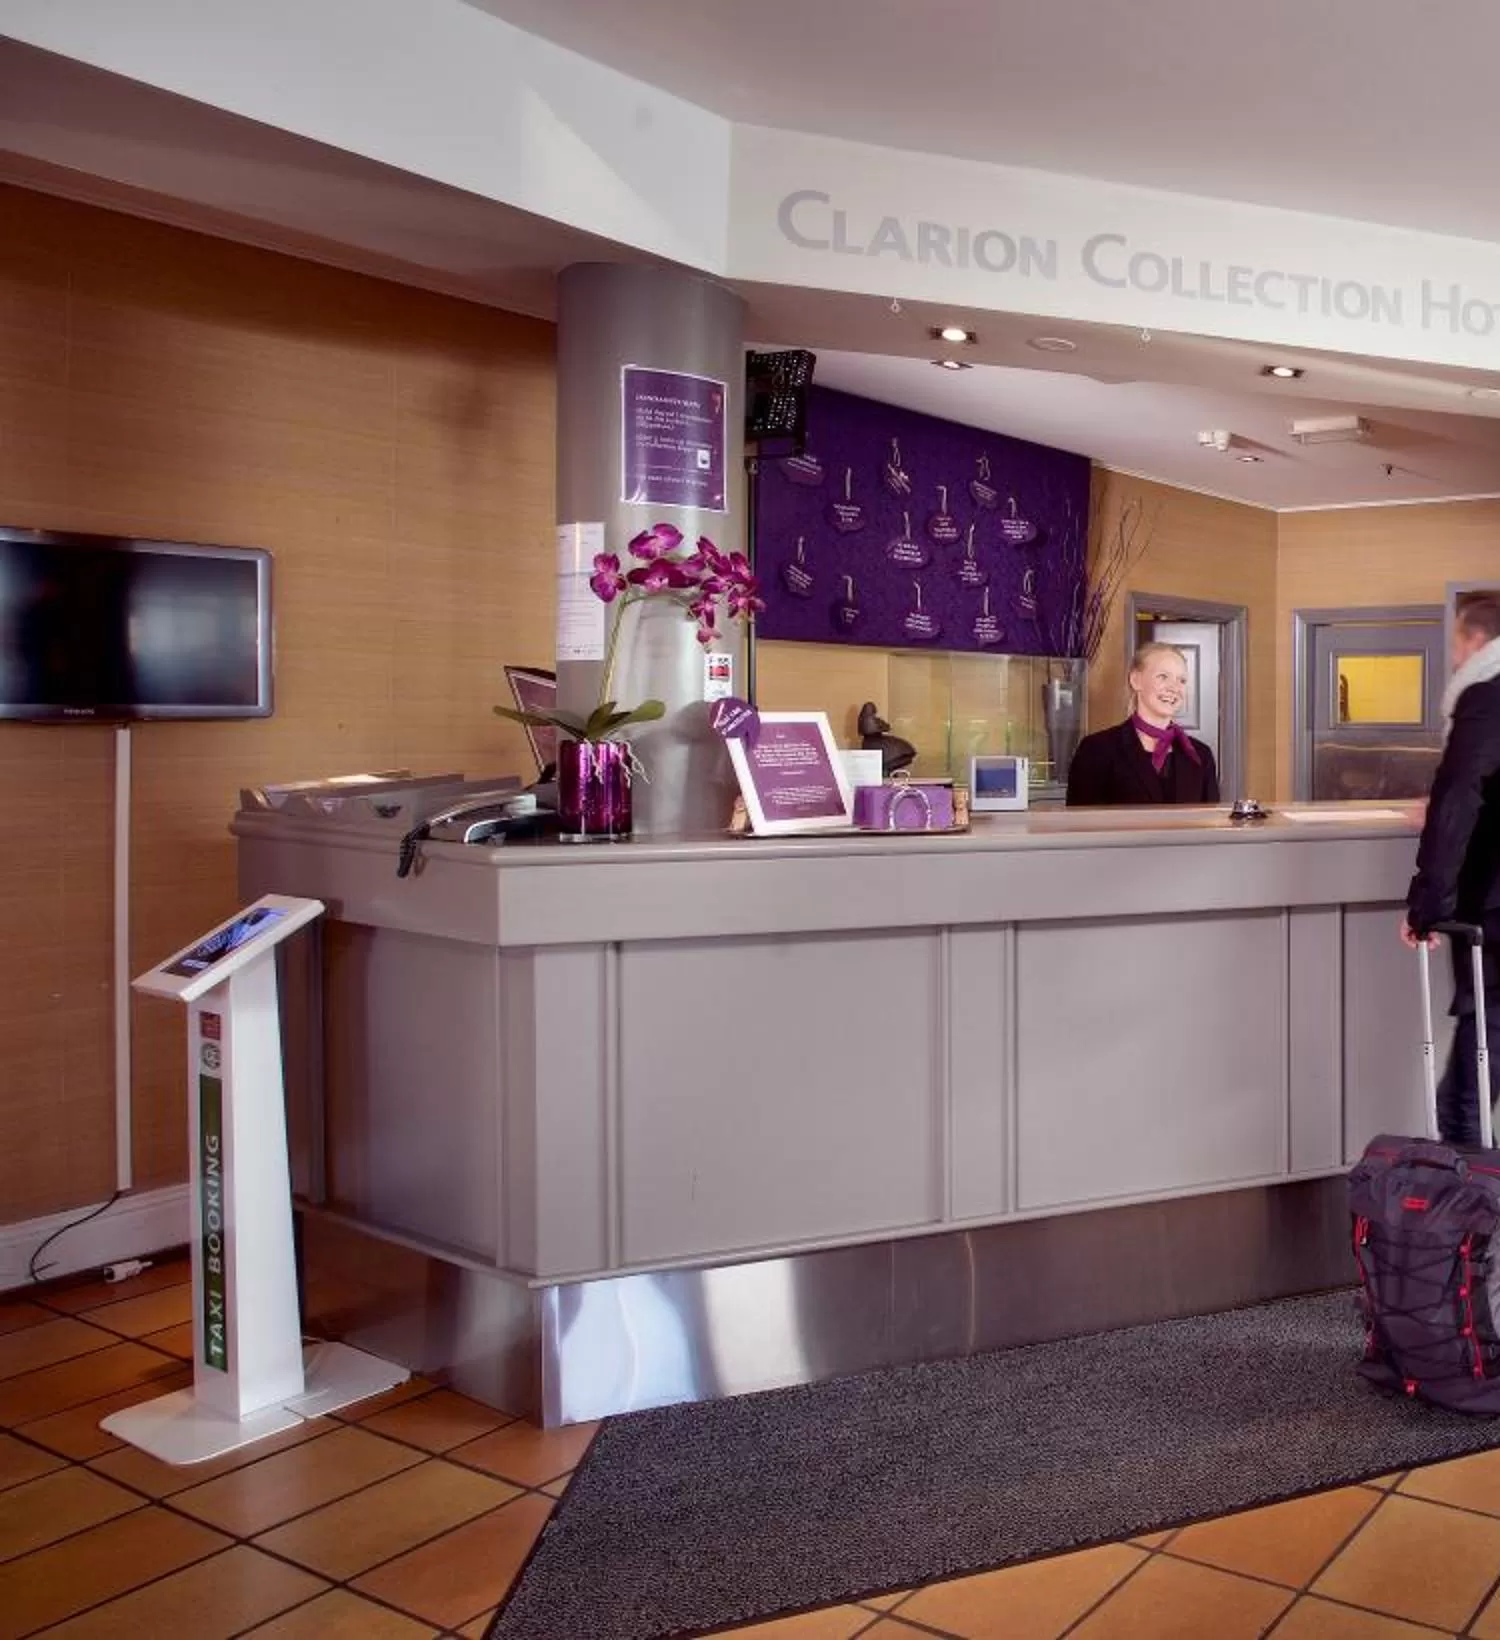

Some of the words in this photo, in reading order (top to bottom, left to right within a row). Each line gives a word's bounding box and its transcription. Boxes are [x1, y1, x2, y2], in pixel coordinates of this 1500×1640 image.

[777, 189, 1058, 281] CLARION
[1080, 233, 1403, 328] COLLECTION
[206, 1134, 222, 1275] BOOKING
[209, 1290, 225, 1356] TAXI
